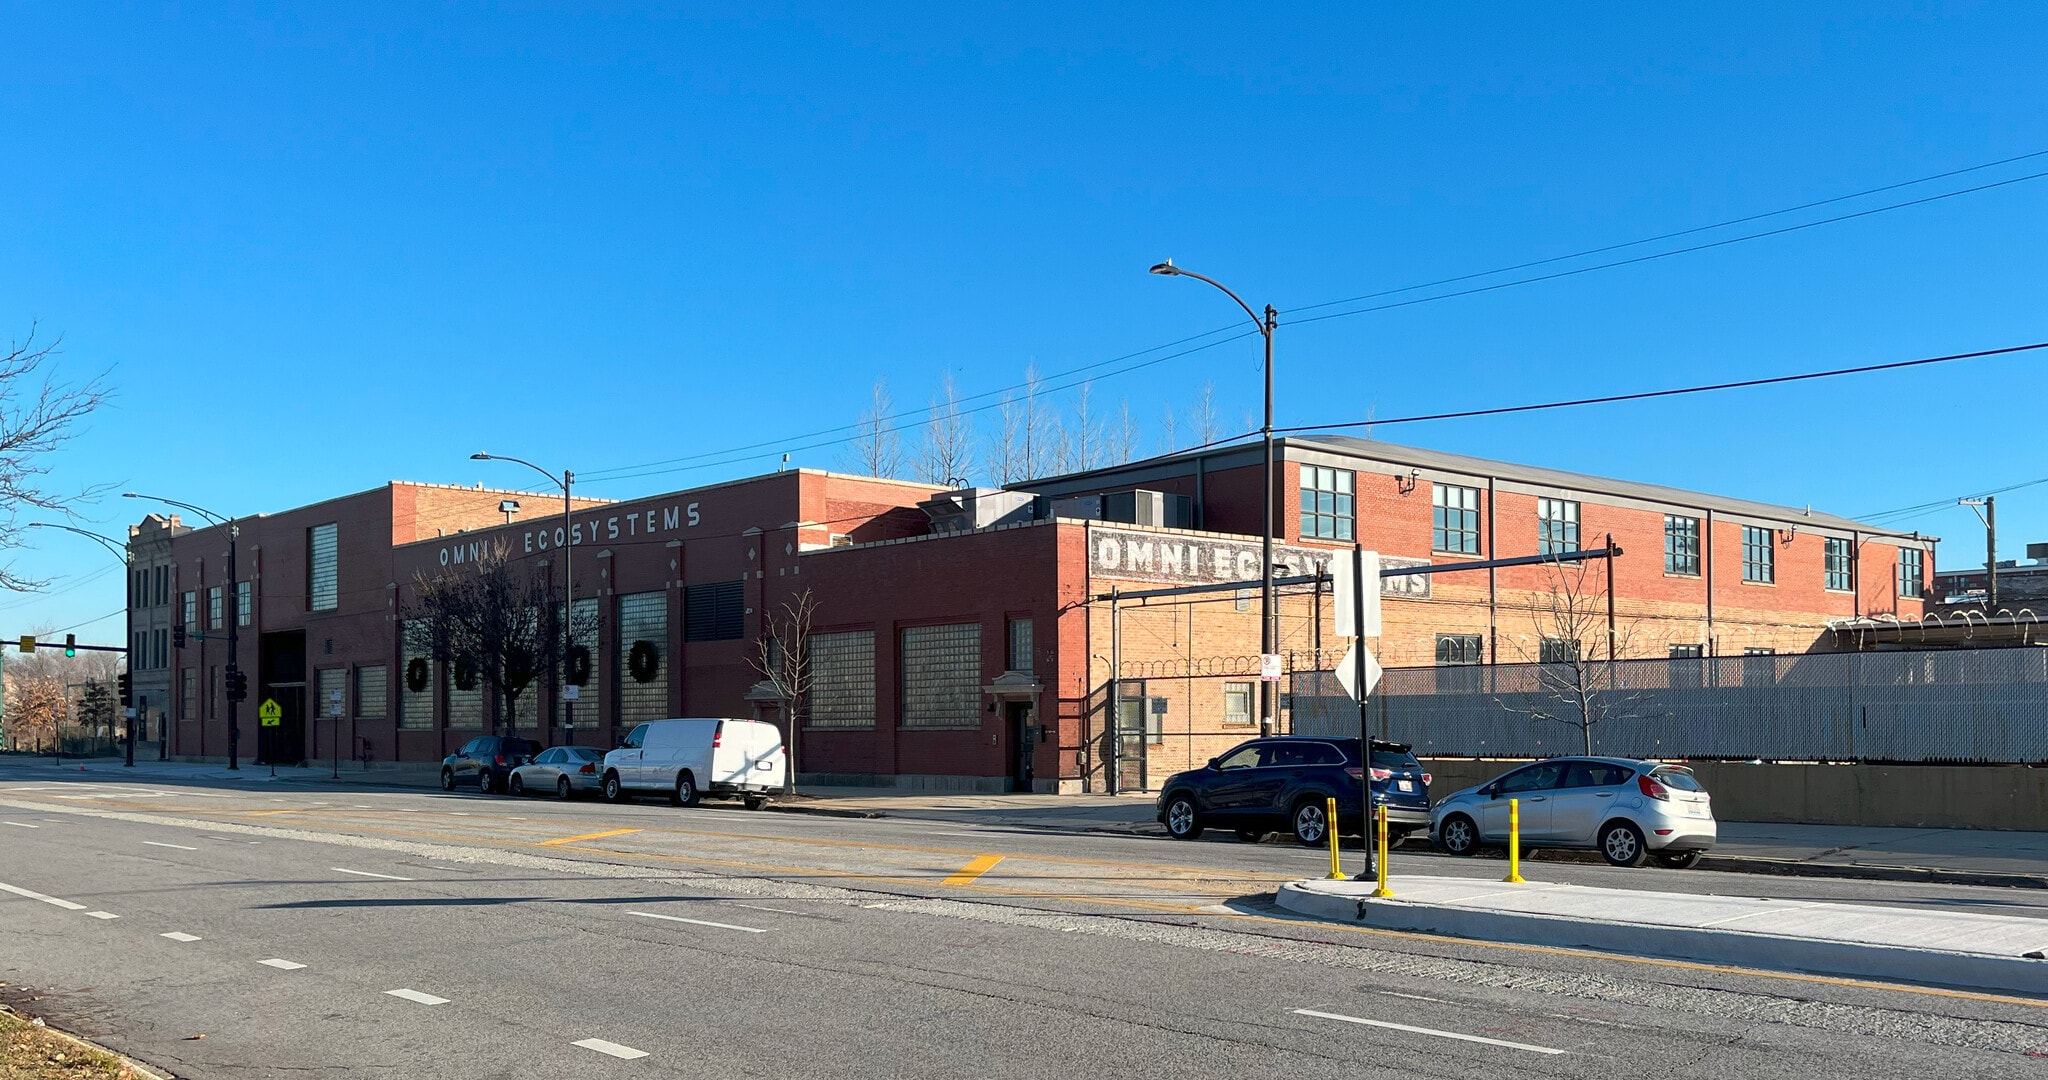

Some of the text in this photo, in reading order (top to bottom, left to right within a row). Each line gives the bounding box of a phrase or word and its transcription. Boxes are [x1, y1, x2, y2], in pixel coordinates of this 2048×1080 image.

[440, 502, 700, 566] OMNI ECOSYSTEMS
[1098, 537, 1199, 576] OMNI
